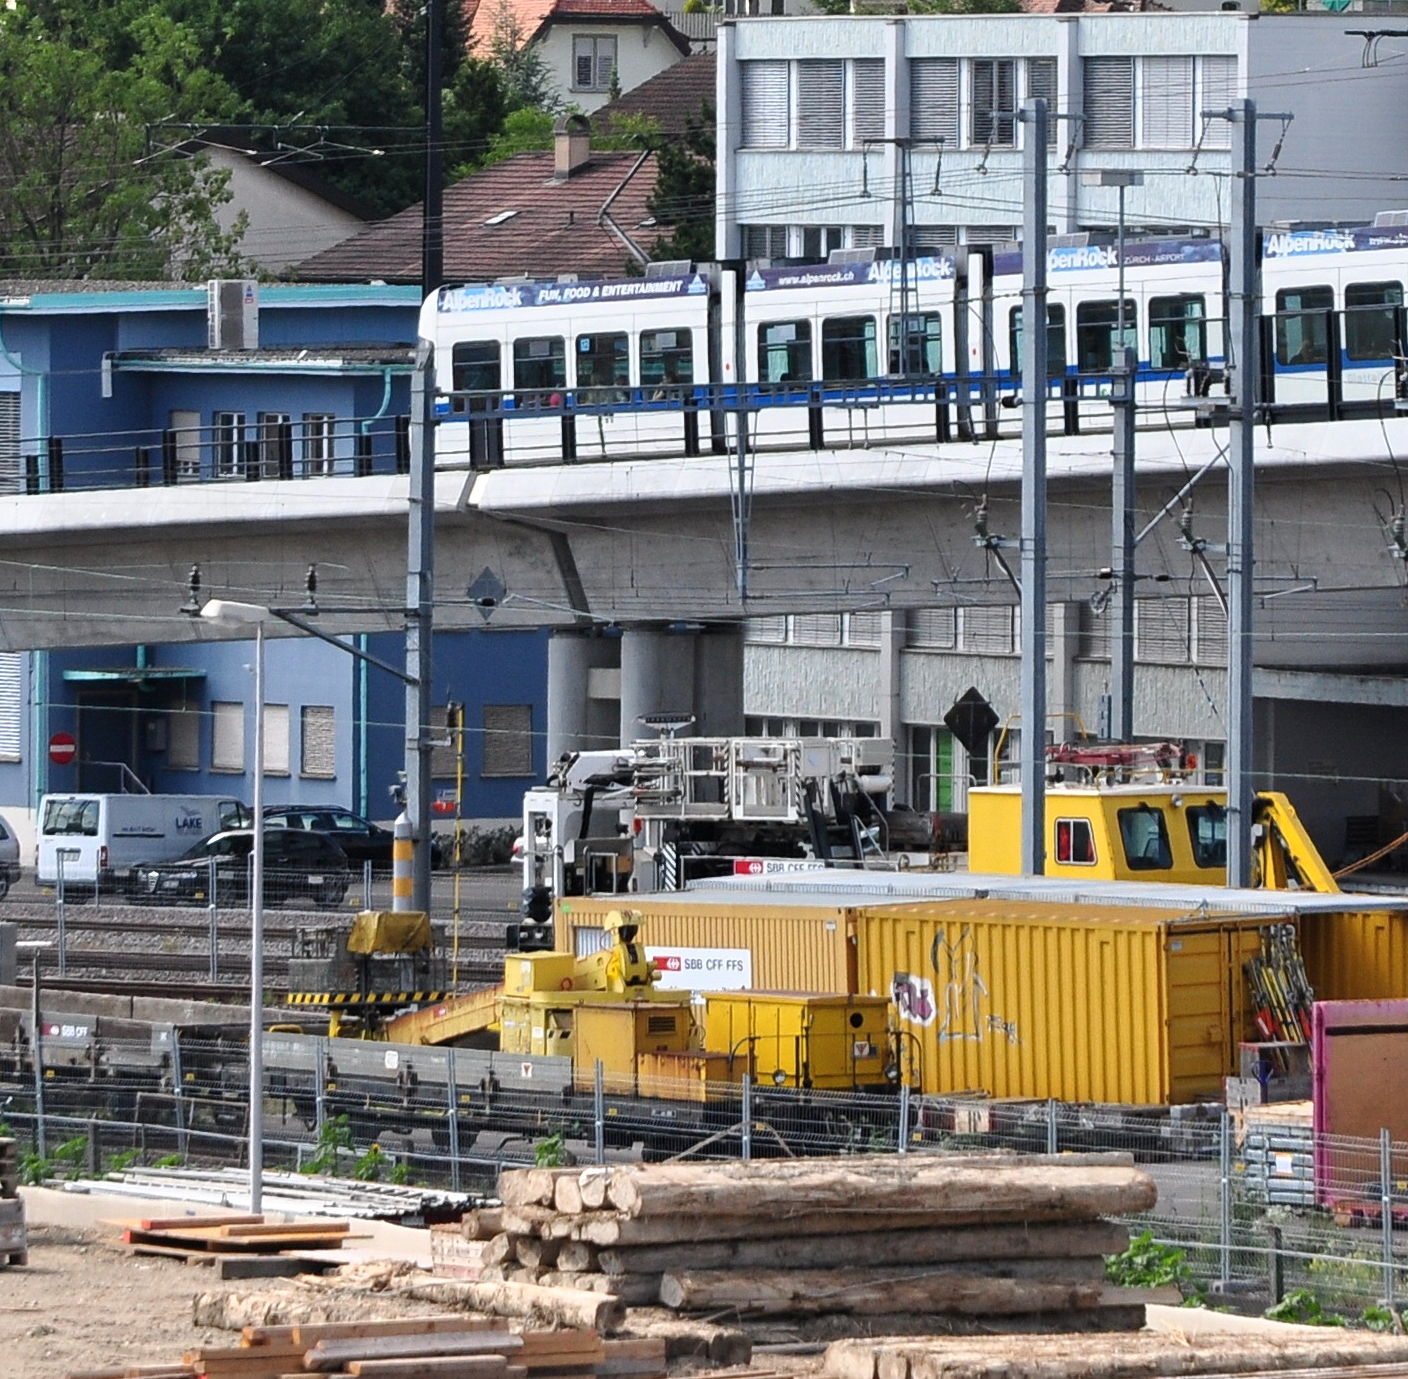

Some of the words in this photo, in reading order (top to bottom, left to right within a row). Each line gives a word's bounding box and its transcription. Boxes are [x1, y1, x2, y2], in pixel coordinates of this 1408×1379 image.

[441, 284, 522, 310] AlpenRock
[539, 289, 563, 303] FUN,
[564, 286, 591, 300] FOOD
[593, 285, 600, 298] &
[602, 280, 683, 297] ENTERTAINMENT
[176, 817, 203, 829] LAKE
[684, 958, 703, 970] SBB
[706, 959, 723, 971] CFF
[726, 960, 744, 972] FFS
